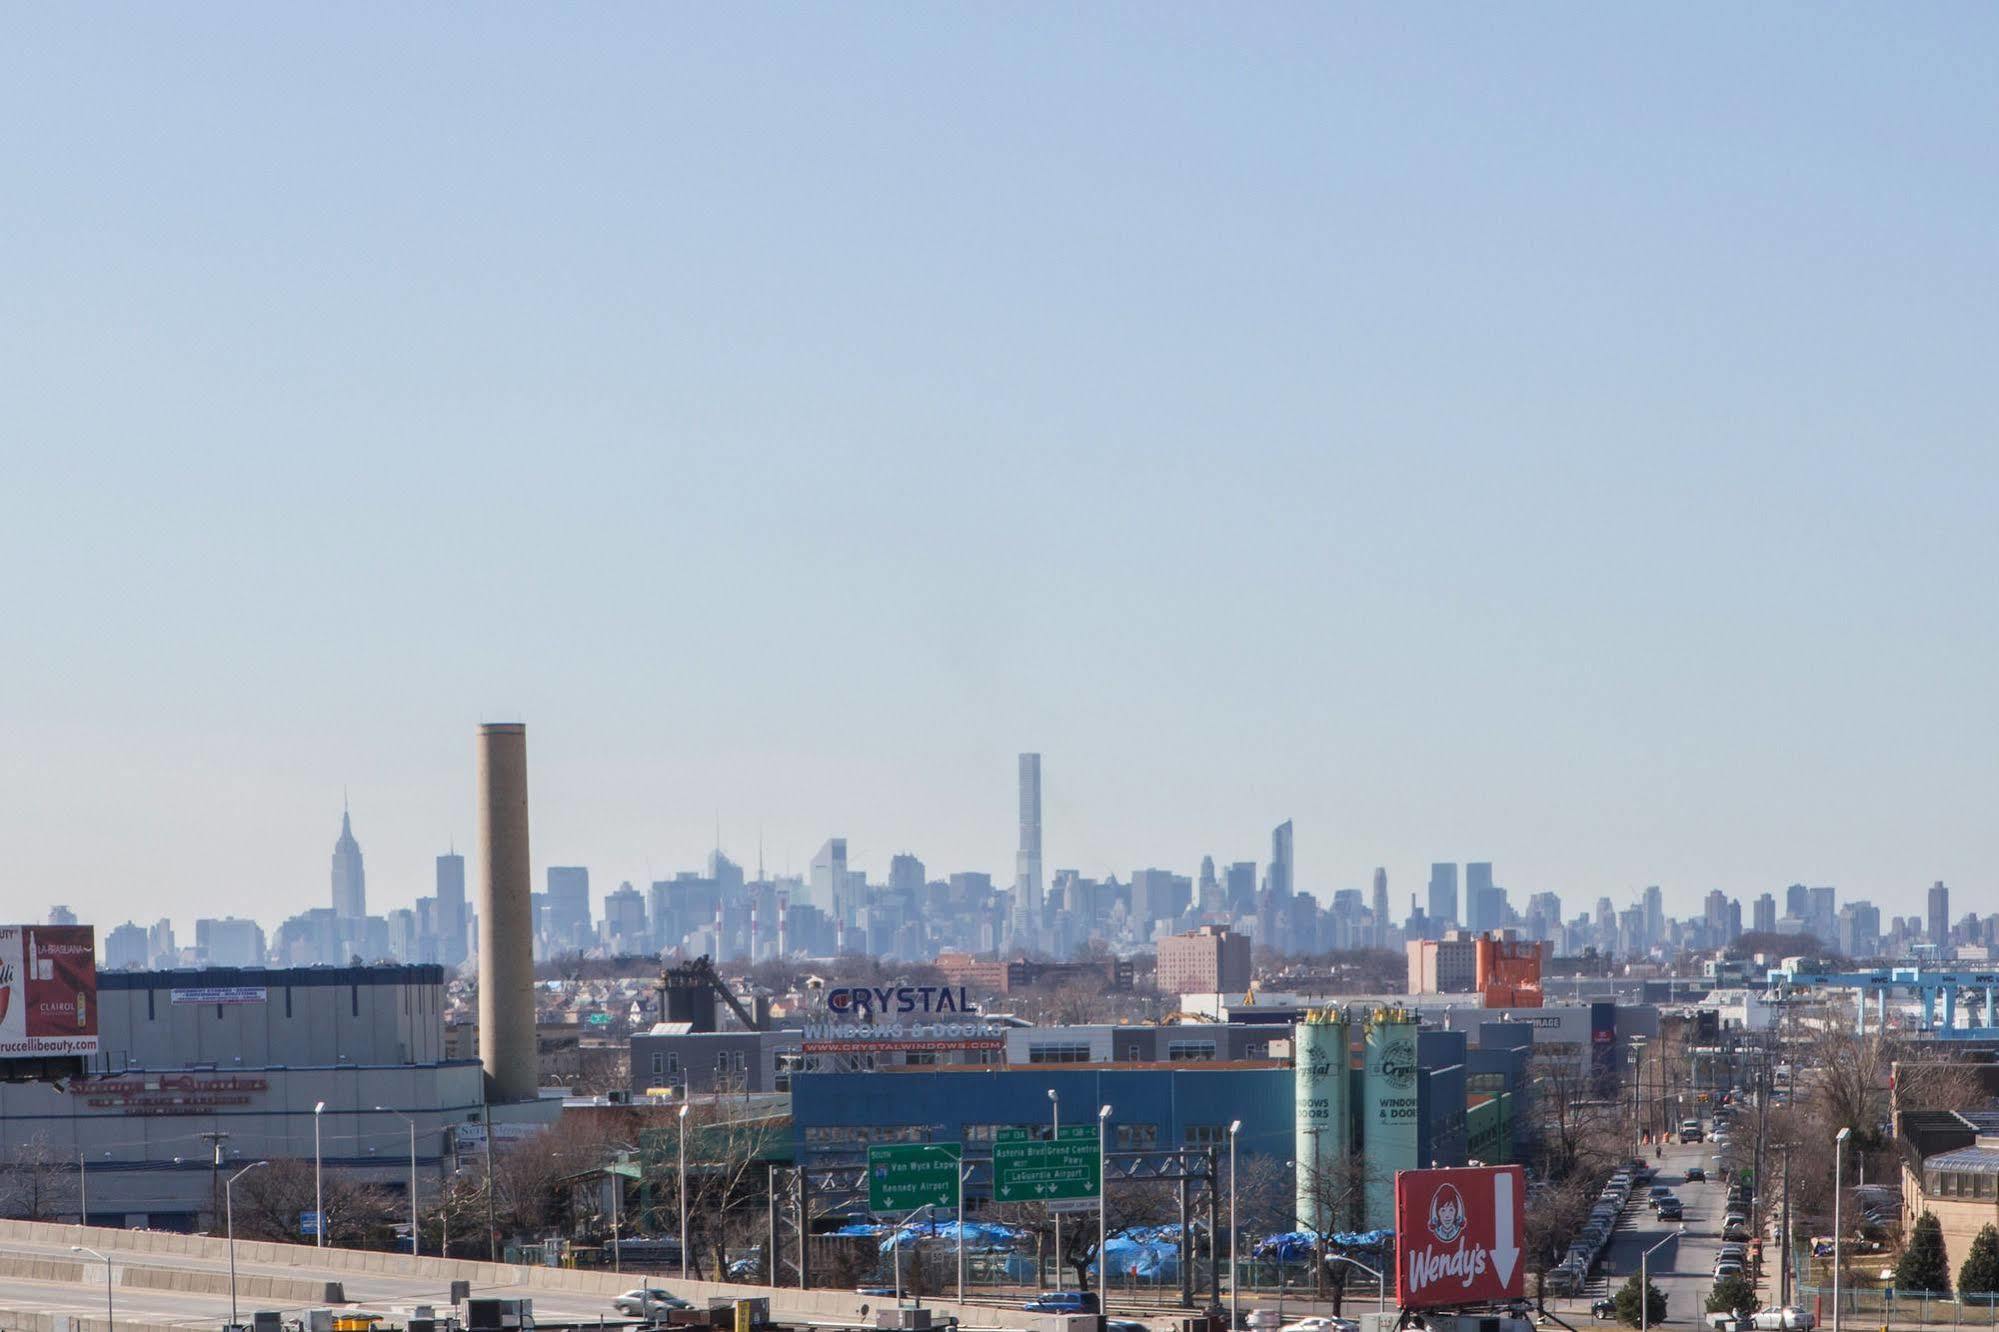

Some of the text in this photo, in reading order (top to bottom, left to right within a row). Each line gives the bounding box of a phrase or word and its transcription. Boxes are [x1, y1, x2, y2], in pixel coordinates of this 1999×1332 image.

[828, 986, 977, 1013] CRYSTAL
[40, 1003, 75, 1011] CLAIROL
[803, 1023, 1001, 1039] WINDOWS & DOORS
[997, 1148, 1024, 1157] Astoria
[1047, 1144, 1100, 1155] Grand Central
[890, 1162, 908, 1171] Van
[910, 1161, 931, 1171] Wyck
[1012, 1169, 1082, 1180] LaGuardia Airport
[882, 1181, 949, 1193] Kennedy Airport
[1409, 1235, 1487, 1293] Wendy's
